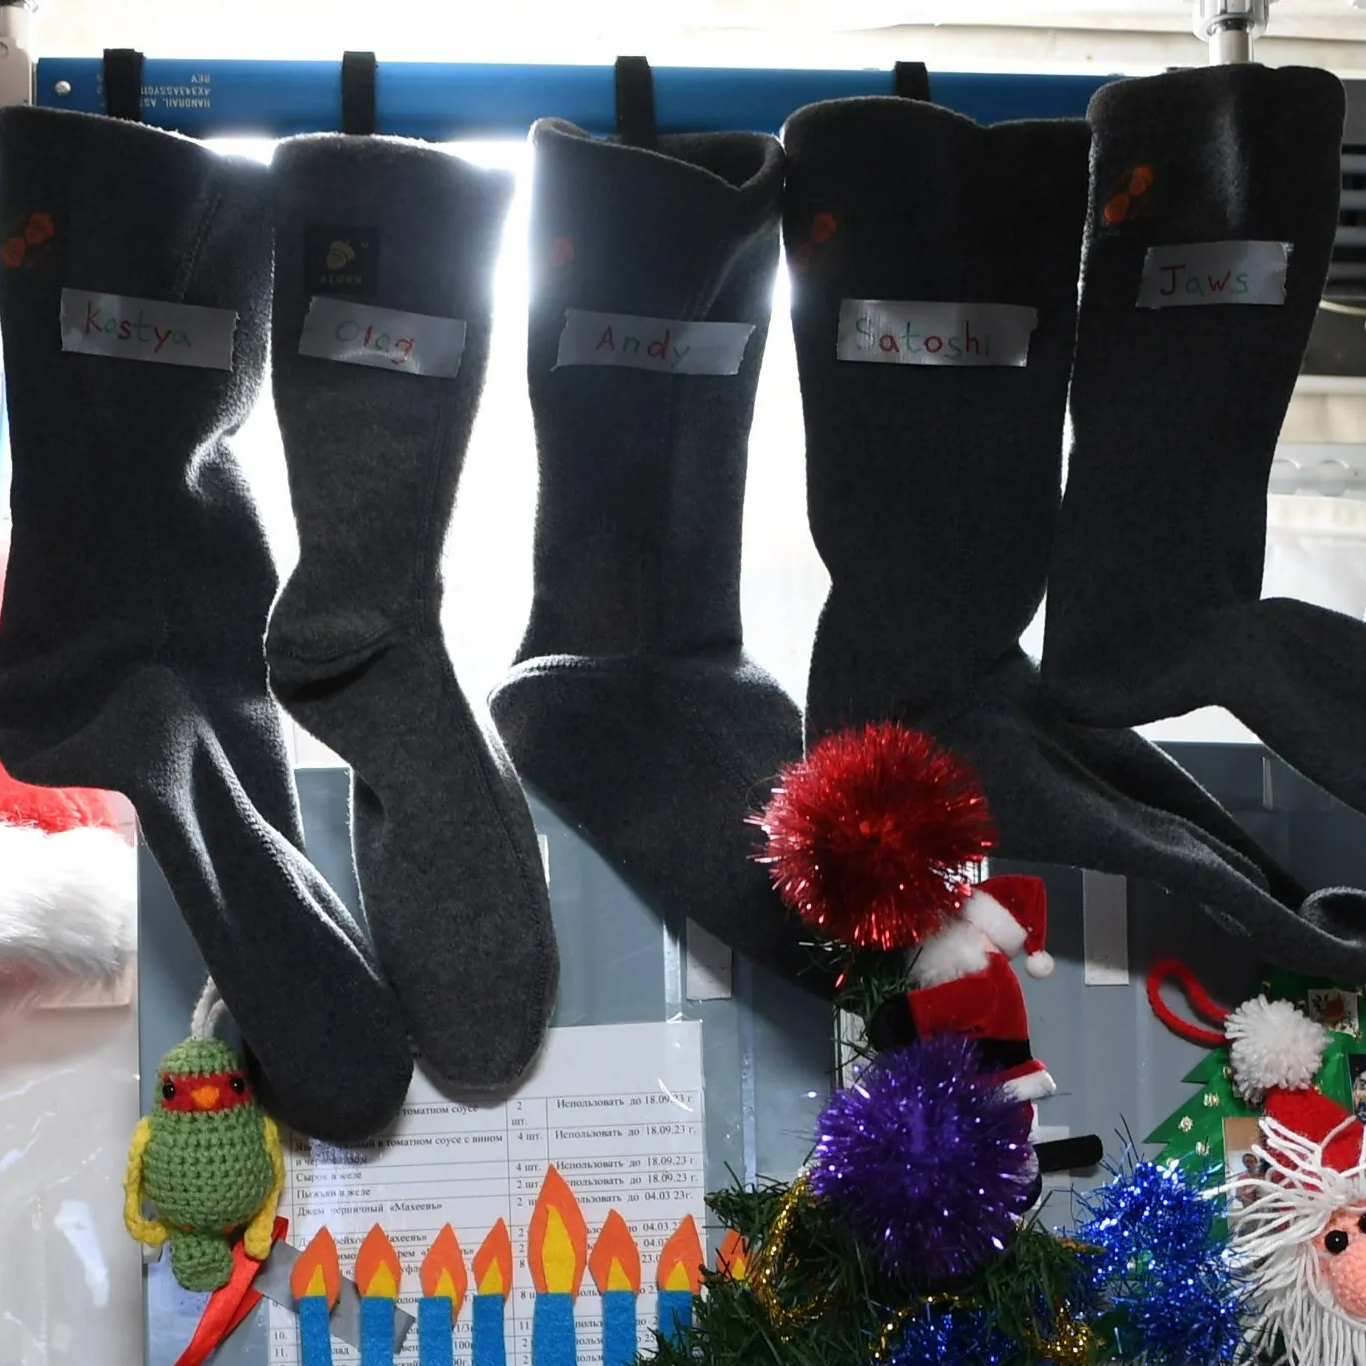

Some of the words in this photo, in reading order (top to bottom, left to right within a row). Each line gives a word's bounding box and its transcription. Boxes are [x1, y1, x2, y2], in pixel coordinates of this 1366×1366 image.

[1160, 265, 1250, 297] Jaws
[86, 303, 191, 352] Kostya
[336, 319, 415, 364] Oleg
[595, 329, 692, 364] Andy
[854, 319, 991, 361] Satoshi
[451, 1104, 478, 1115] соусе
[556, 1096, 625, 1109] Использовать
[629, 1096, 642, 1107] до
[554, 1128, 623, 1140] Использовать
[628, 1127, 641, 1137] до
[646, 1124, 687, 1135] 18.09.23
[435, 1136, 463, 1147] соусе
[628, 1158, 641, 1168] до
[646, 1155, 687, 1167] 18.09.23
[565, 1176, 624, 1188] спользовать
[629, 1175, 642, 1185] до
[647, 1172, 687, 1184] 18.09.23
[627, 1192, 640, 1202] до
